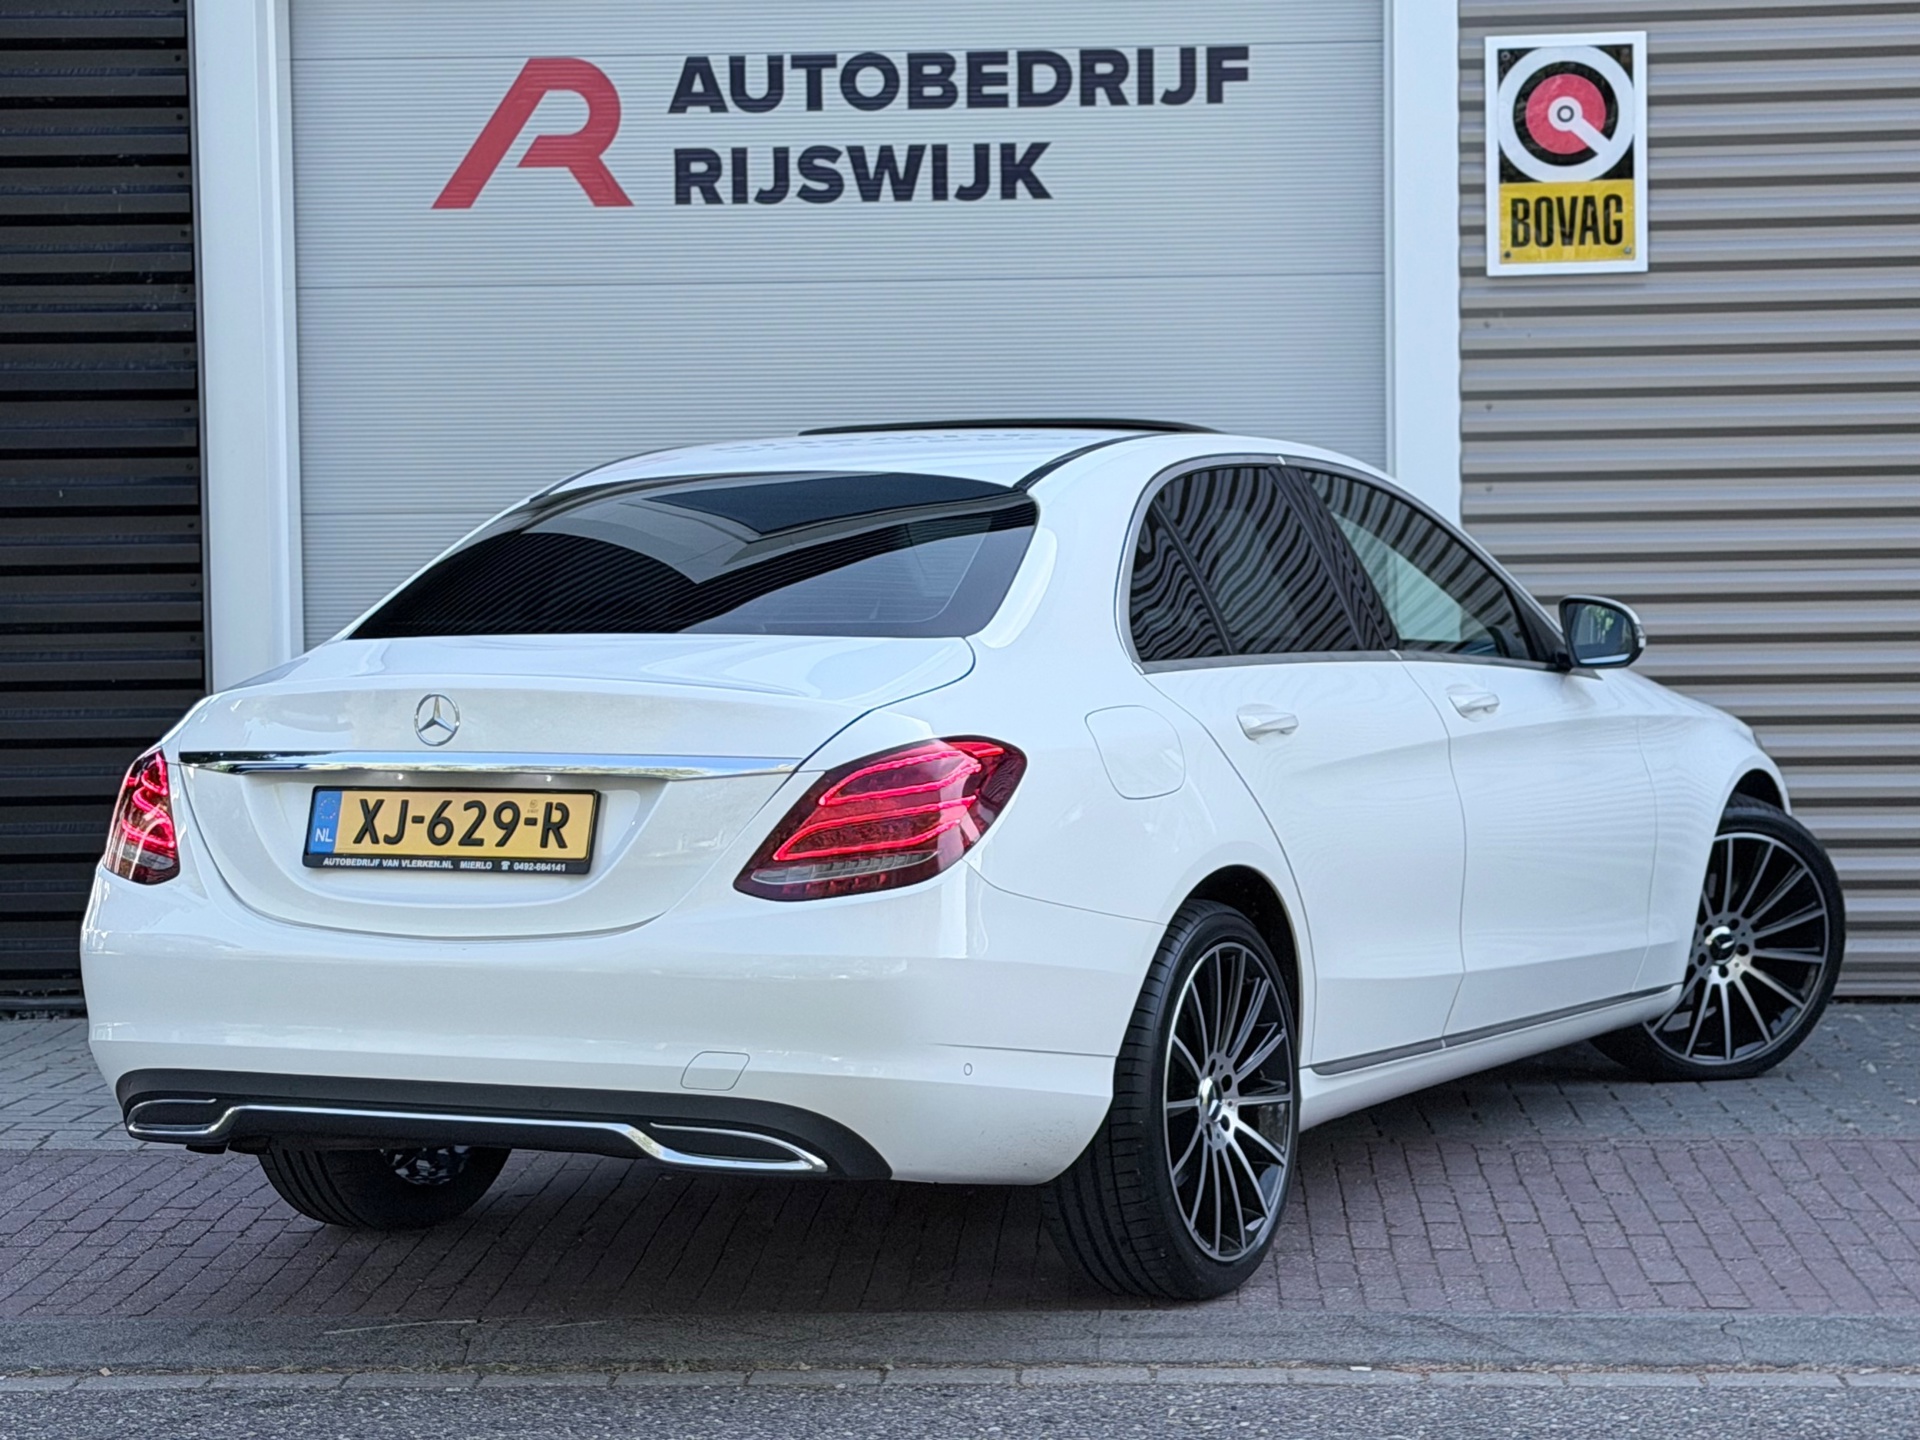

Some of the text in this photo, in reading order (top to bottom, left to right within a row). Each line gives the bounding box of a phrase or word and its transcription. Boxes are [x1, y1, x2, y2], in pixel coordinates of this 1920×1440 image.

[668, 46, 1250, 114] AUTOBEDRIJF
[673, 141, 1053, 205] RIJSWIJK
[1510, 193, 1624, 247] BOVAG
[314, 827, 333, 842] NL
[352, 798, 570, 849] XJ-629-R
[323, 857, 380, 867] AUTOBEDRIJF
[382, 858, 399, 868] VAN
[401, 859, 453, 869] VLERKEN.NL
[460, 860, 493, 869] MIERLO
